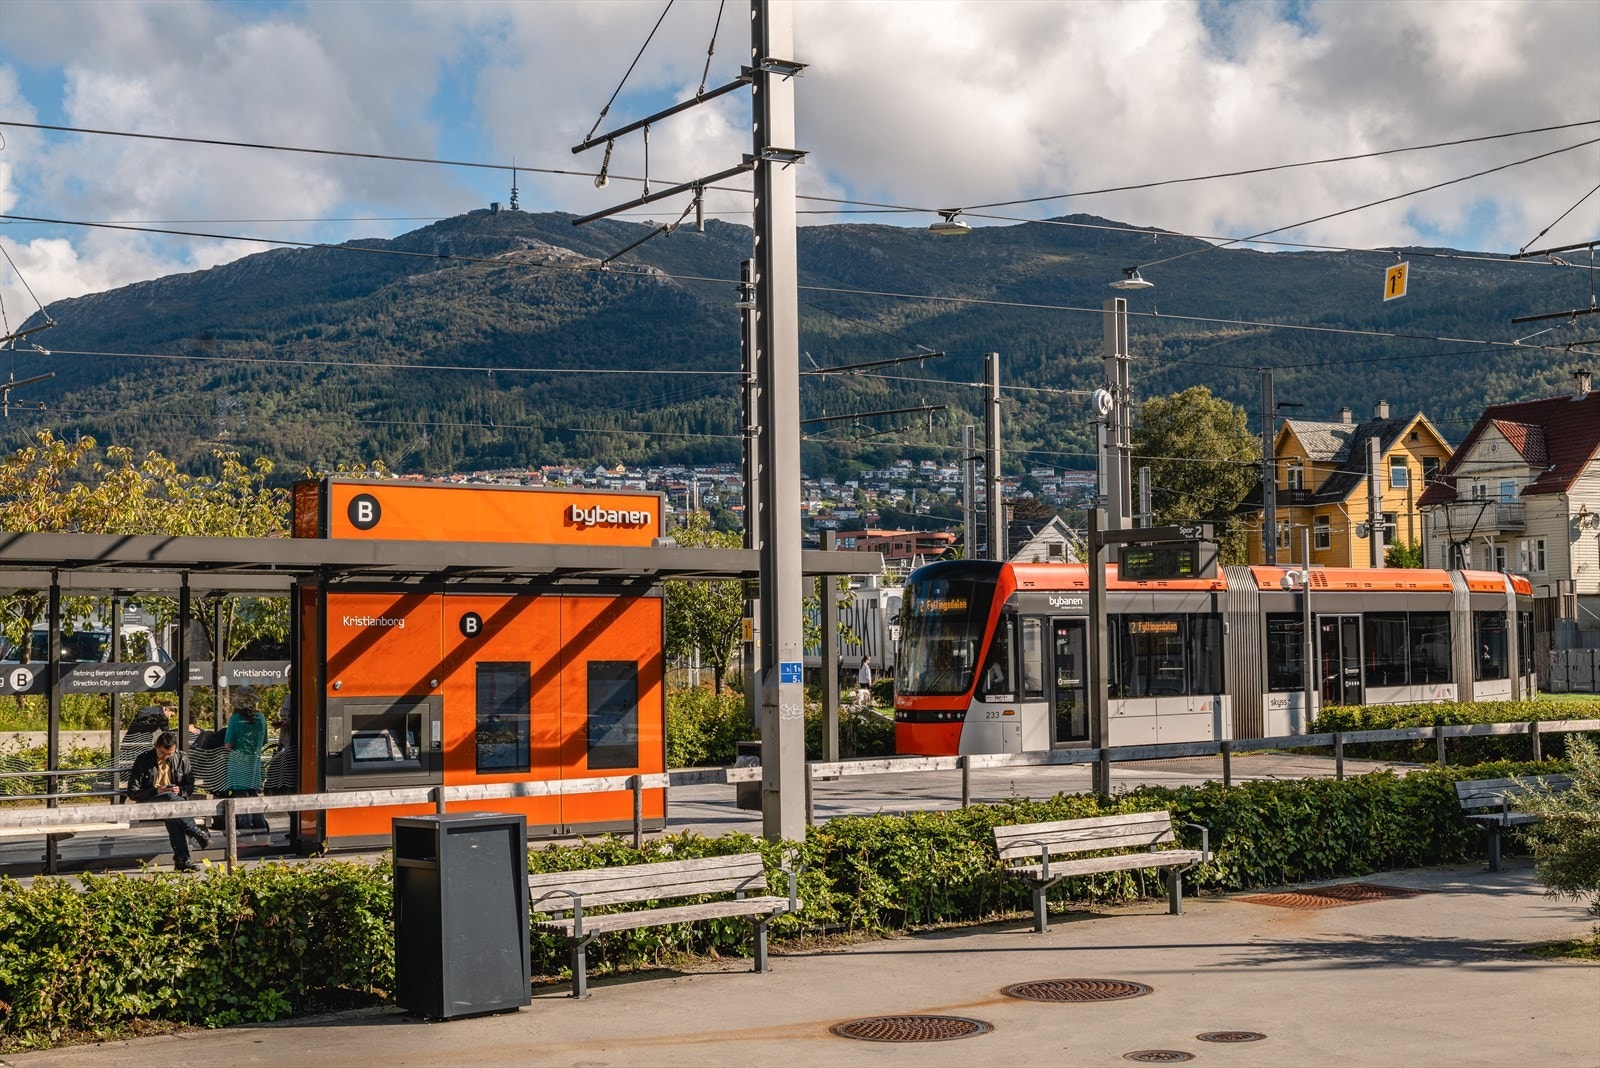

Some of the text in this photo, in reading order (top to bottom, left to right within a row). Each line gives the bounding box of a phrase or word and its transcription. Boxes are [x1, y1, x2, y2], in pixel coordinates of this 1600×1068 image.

[357, 500, 373, 522] B
[572, 504, 651, 525] bybanen
[1179, 525, 1202, 538] Spor 2
[1049, 596, 1083, 607] bybanen
[342, 615, 405, 628] Kristianborg
[466, 617, 477, 633] B
[1131, 621, 1136, 633] 2
[233, 669, 281, 678] Kristianborg
[16, 673, 28, 687] B
[99, 679, 111, 687] City
[1270, 697, 1287, 708] skyss
[985, 711, 1000, 719] 233
